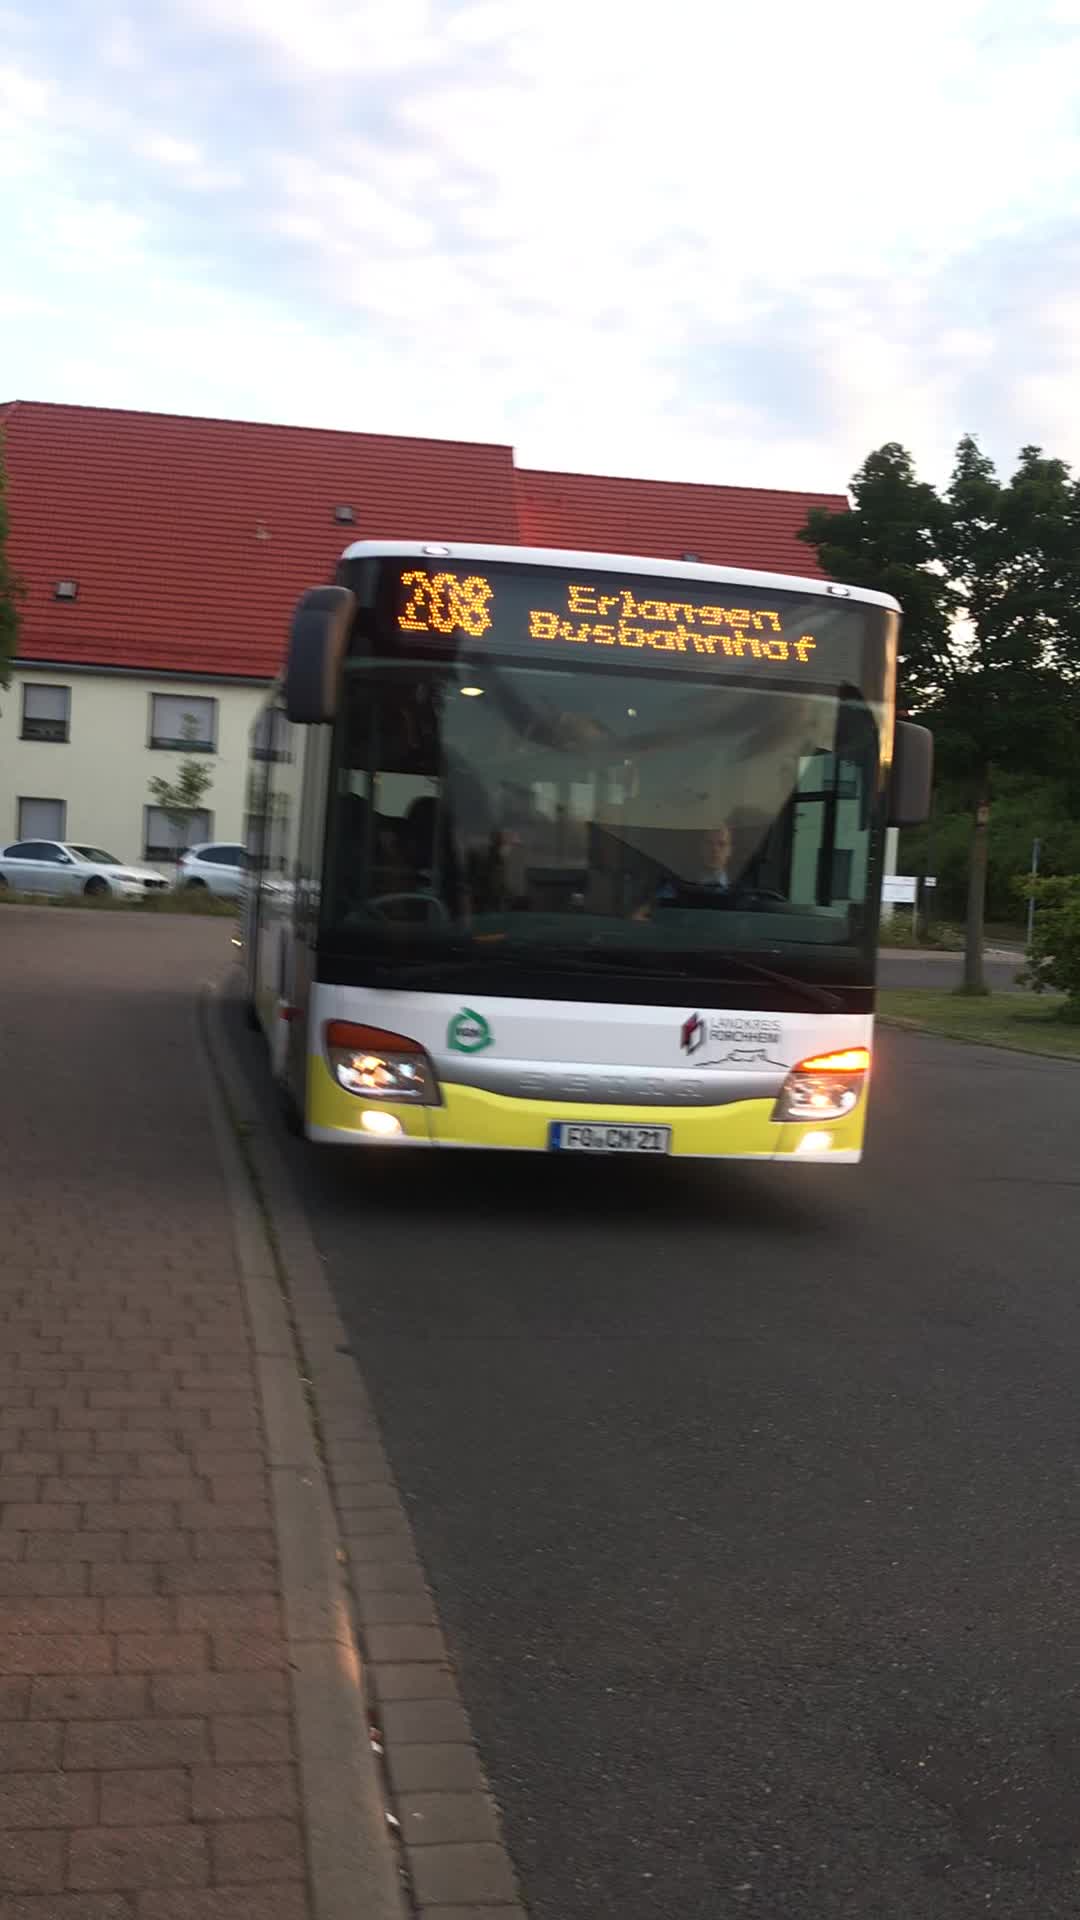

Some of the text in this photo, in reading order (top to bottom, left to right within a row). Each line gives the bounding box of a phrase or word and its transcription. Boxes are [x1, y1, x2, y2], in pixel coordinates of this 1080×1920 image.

[398, 570, 494, 636] 208
[567, 585, 781, 631] Erlangen
[529, 610, 816, 662] Busbahnhof
